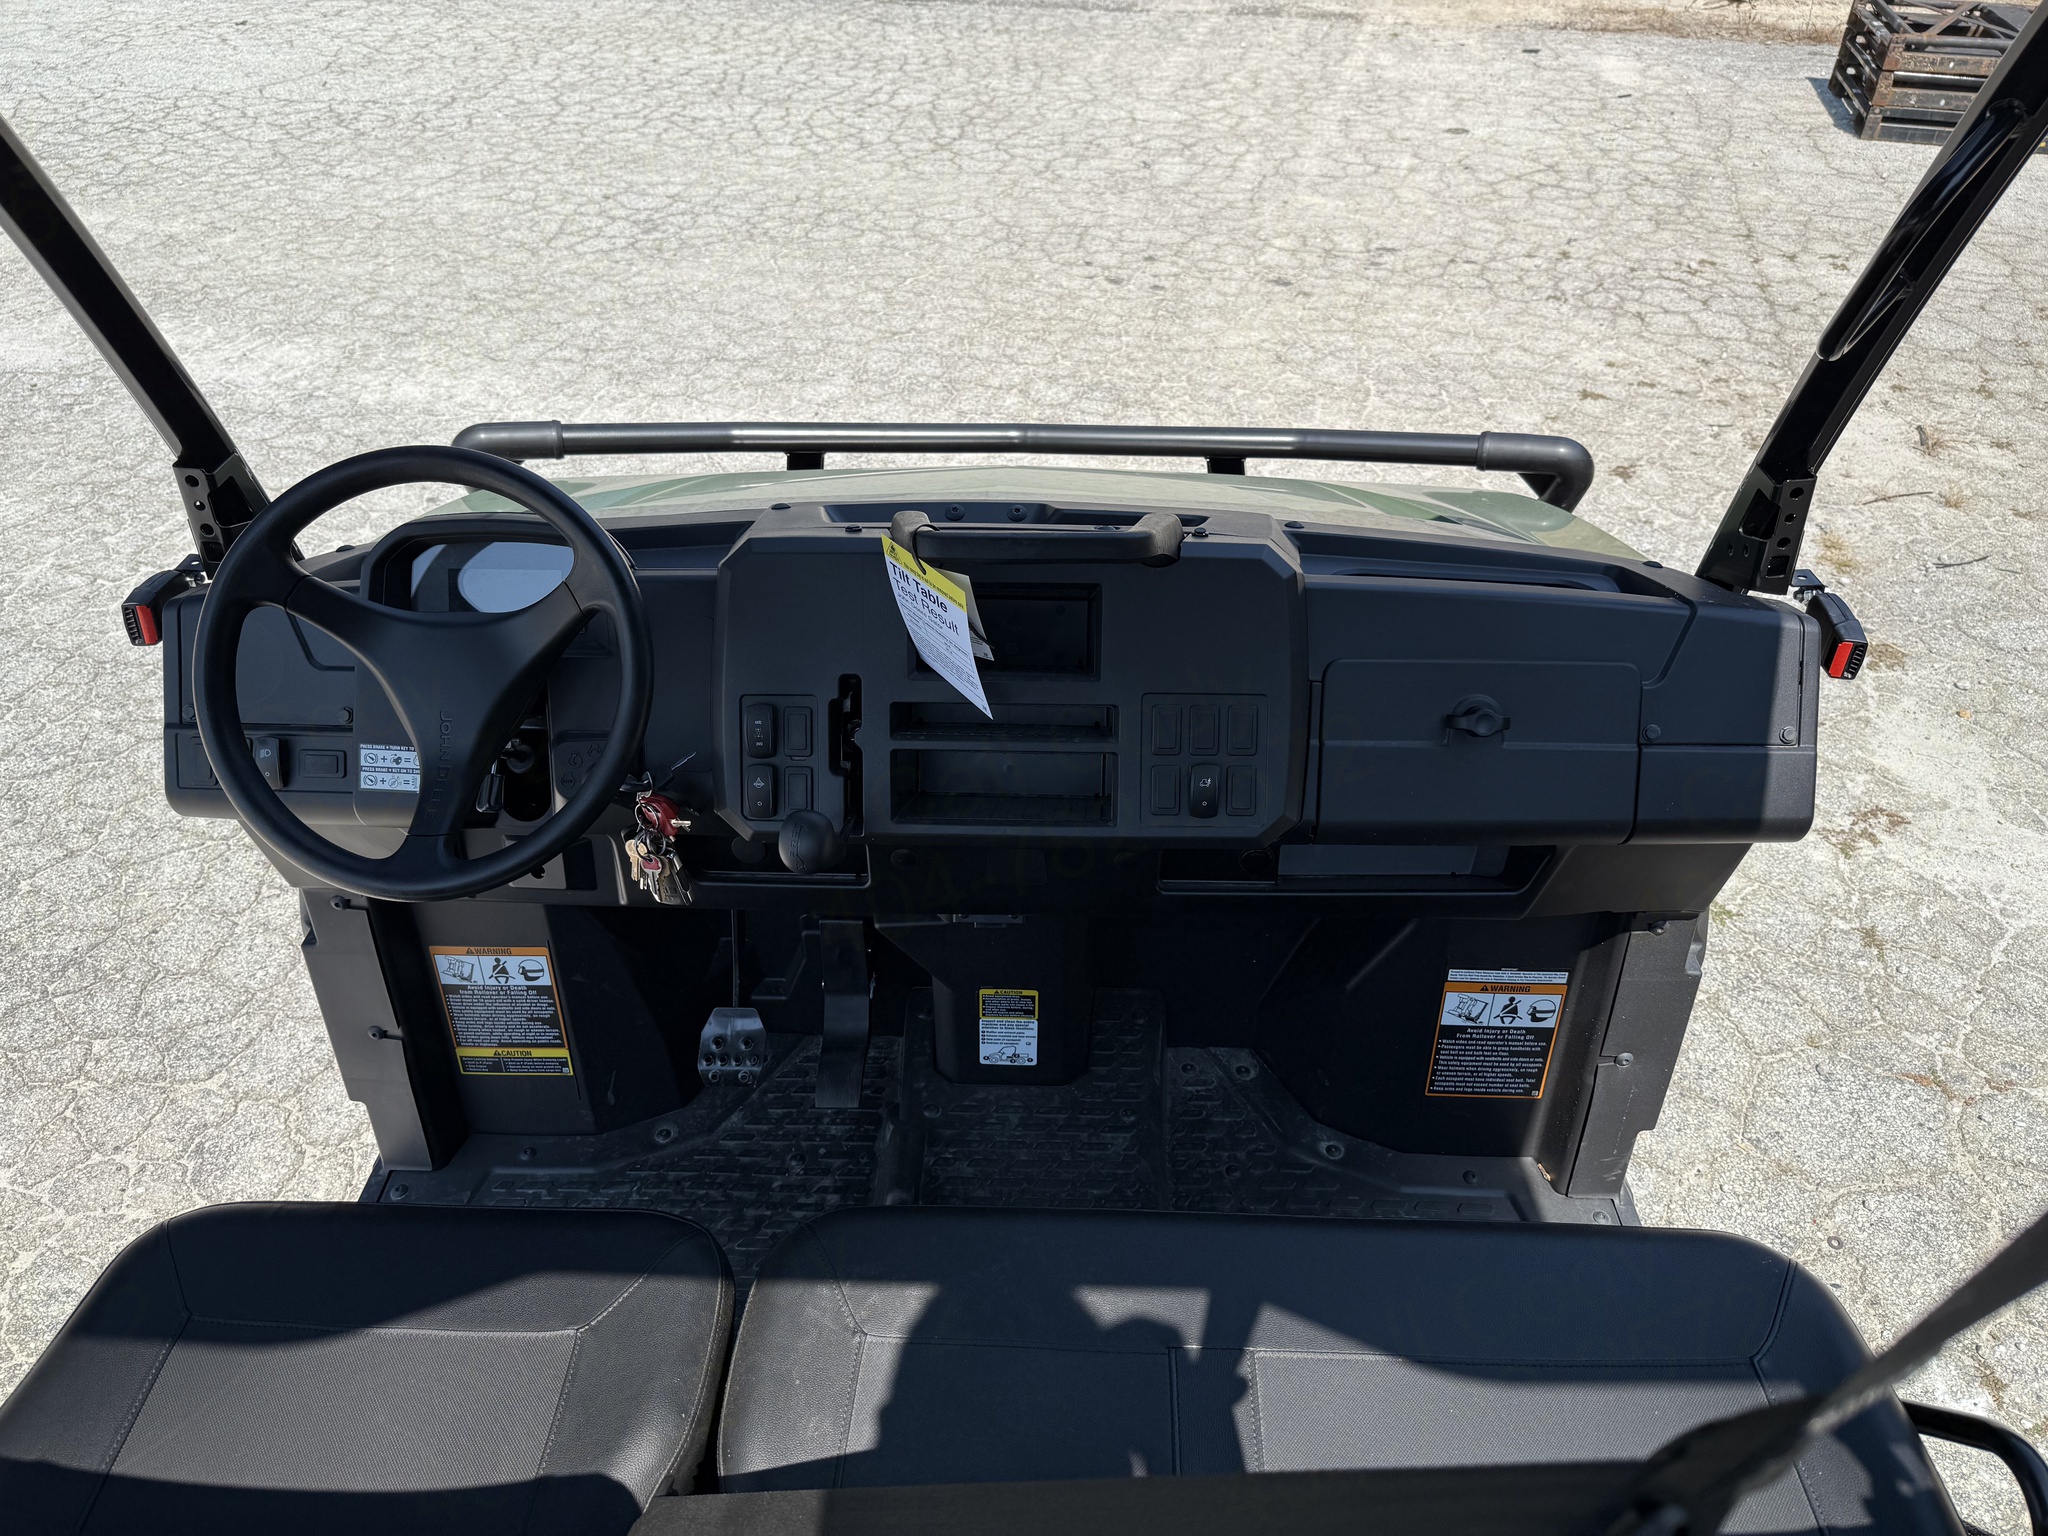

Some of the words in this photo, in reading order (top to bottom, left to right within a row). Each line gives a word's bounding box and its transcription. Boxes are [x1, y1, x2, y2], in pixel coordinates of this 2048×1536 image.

[890, 561, 911, 586] Tilt
[912, 578, 947, 612] Table
[893, 577, 918, 605] Test
[921, 598, 959, 636] Result
[440, 710, 452, 761] JOHN
[424, 764, 451, 820] DEERE
